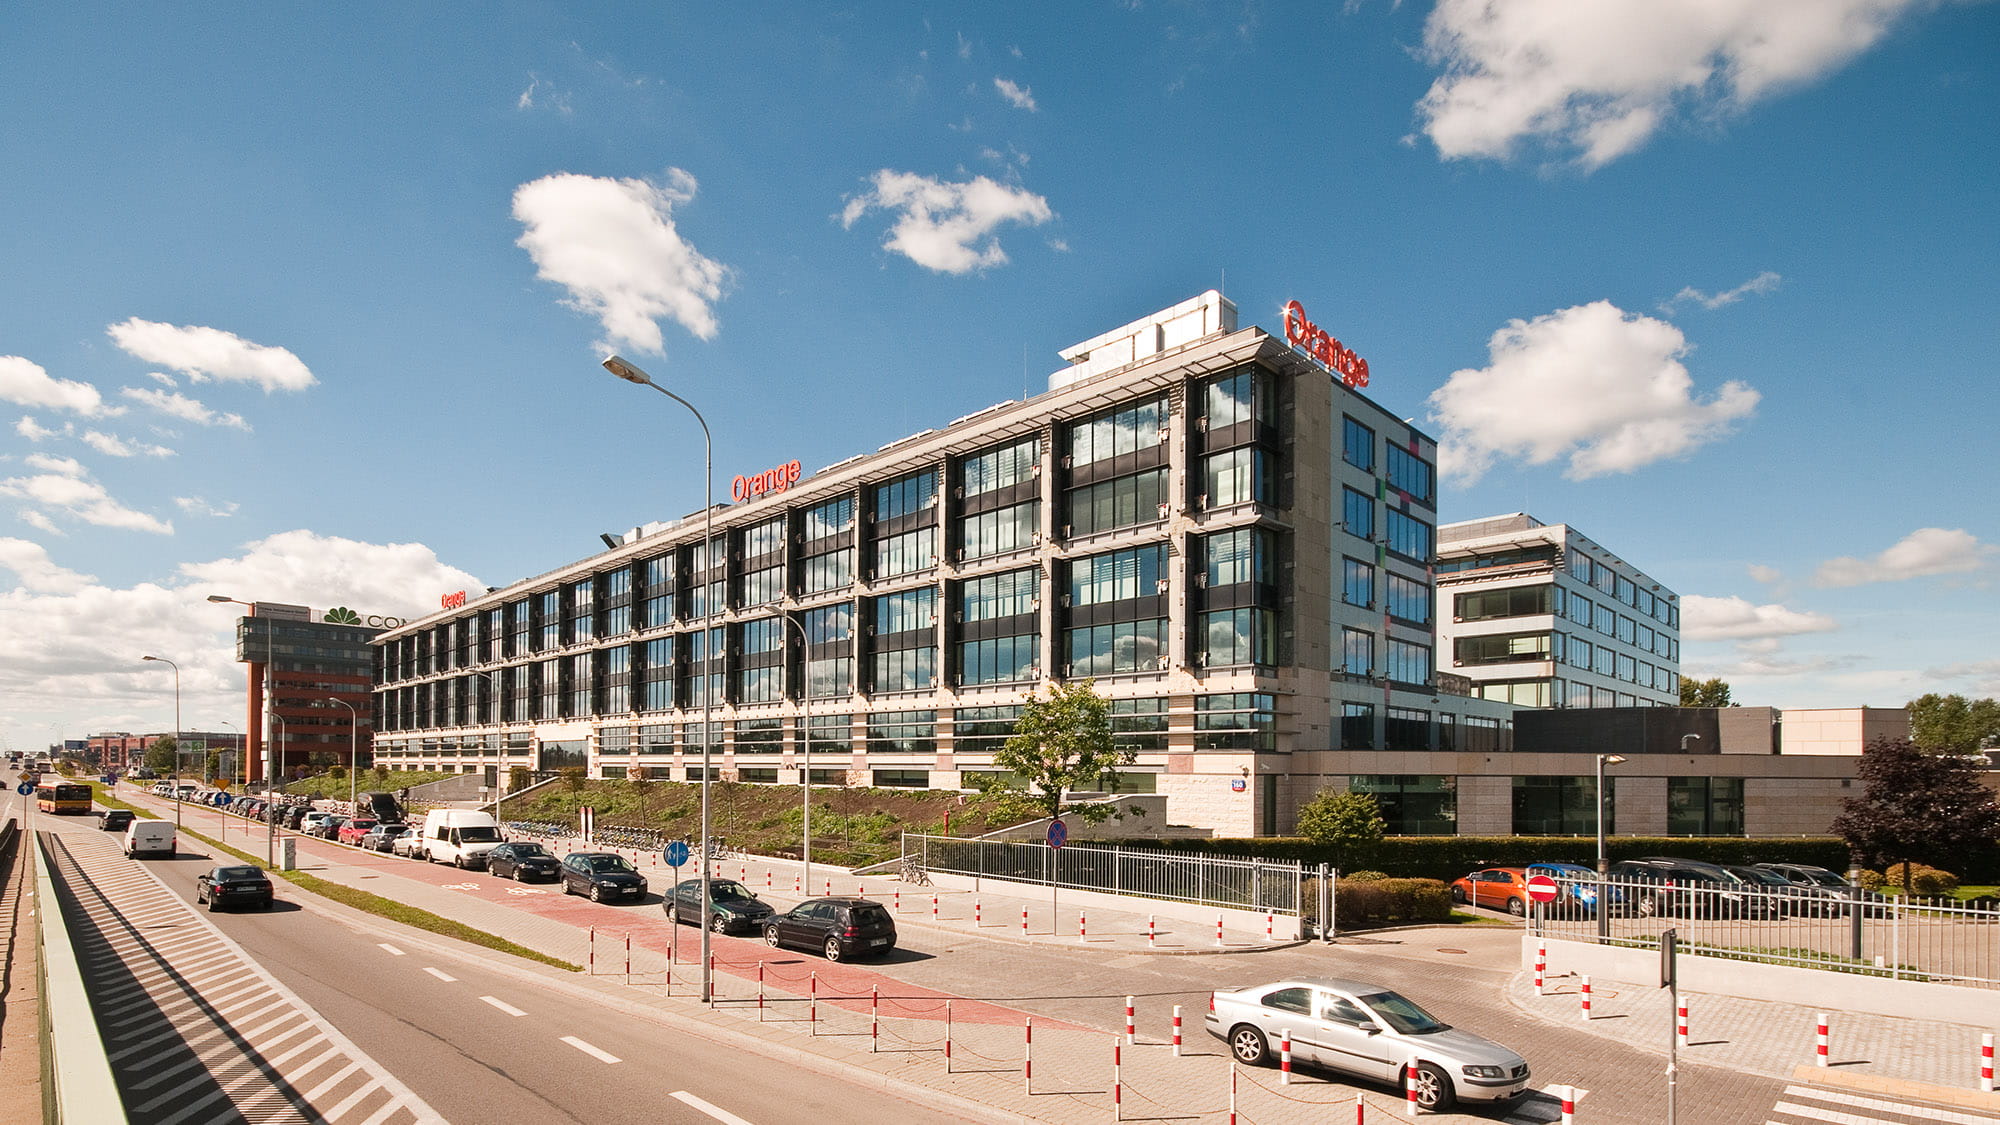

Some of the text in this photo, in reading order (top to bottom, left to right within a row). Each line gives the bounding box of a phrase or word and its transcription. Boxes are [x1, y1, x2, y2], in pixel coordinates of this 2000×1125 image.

[1284, 300, 1369, 388] Orange
[731, 459, 801, 502] Orange
[442, 590, 465, 609] Orange
